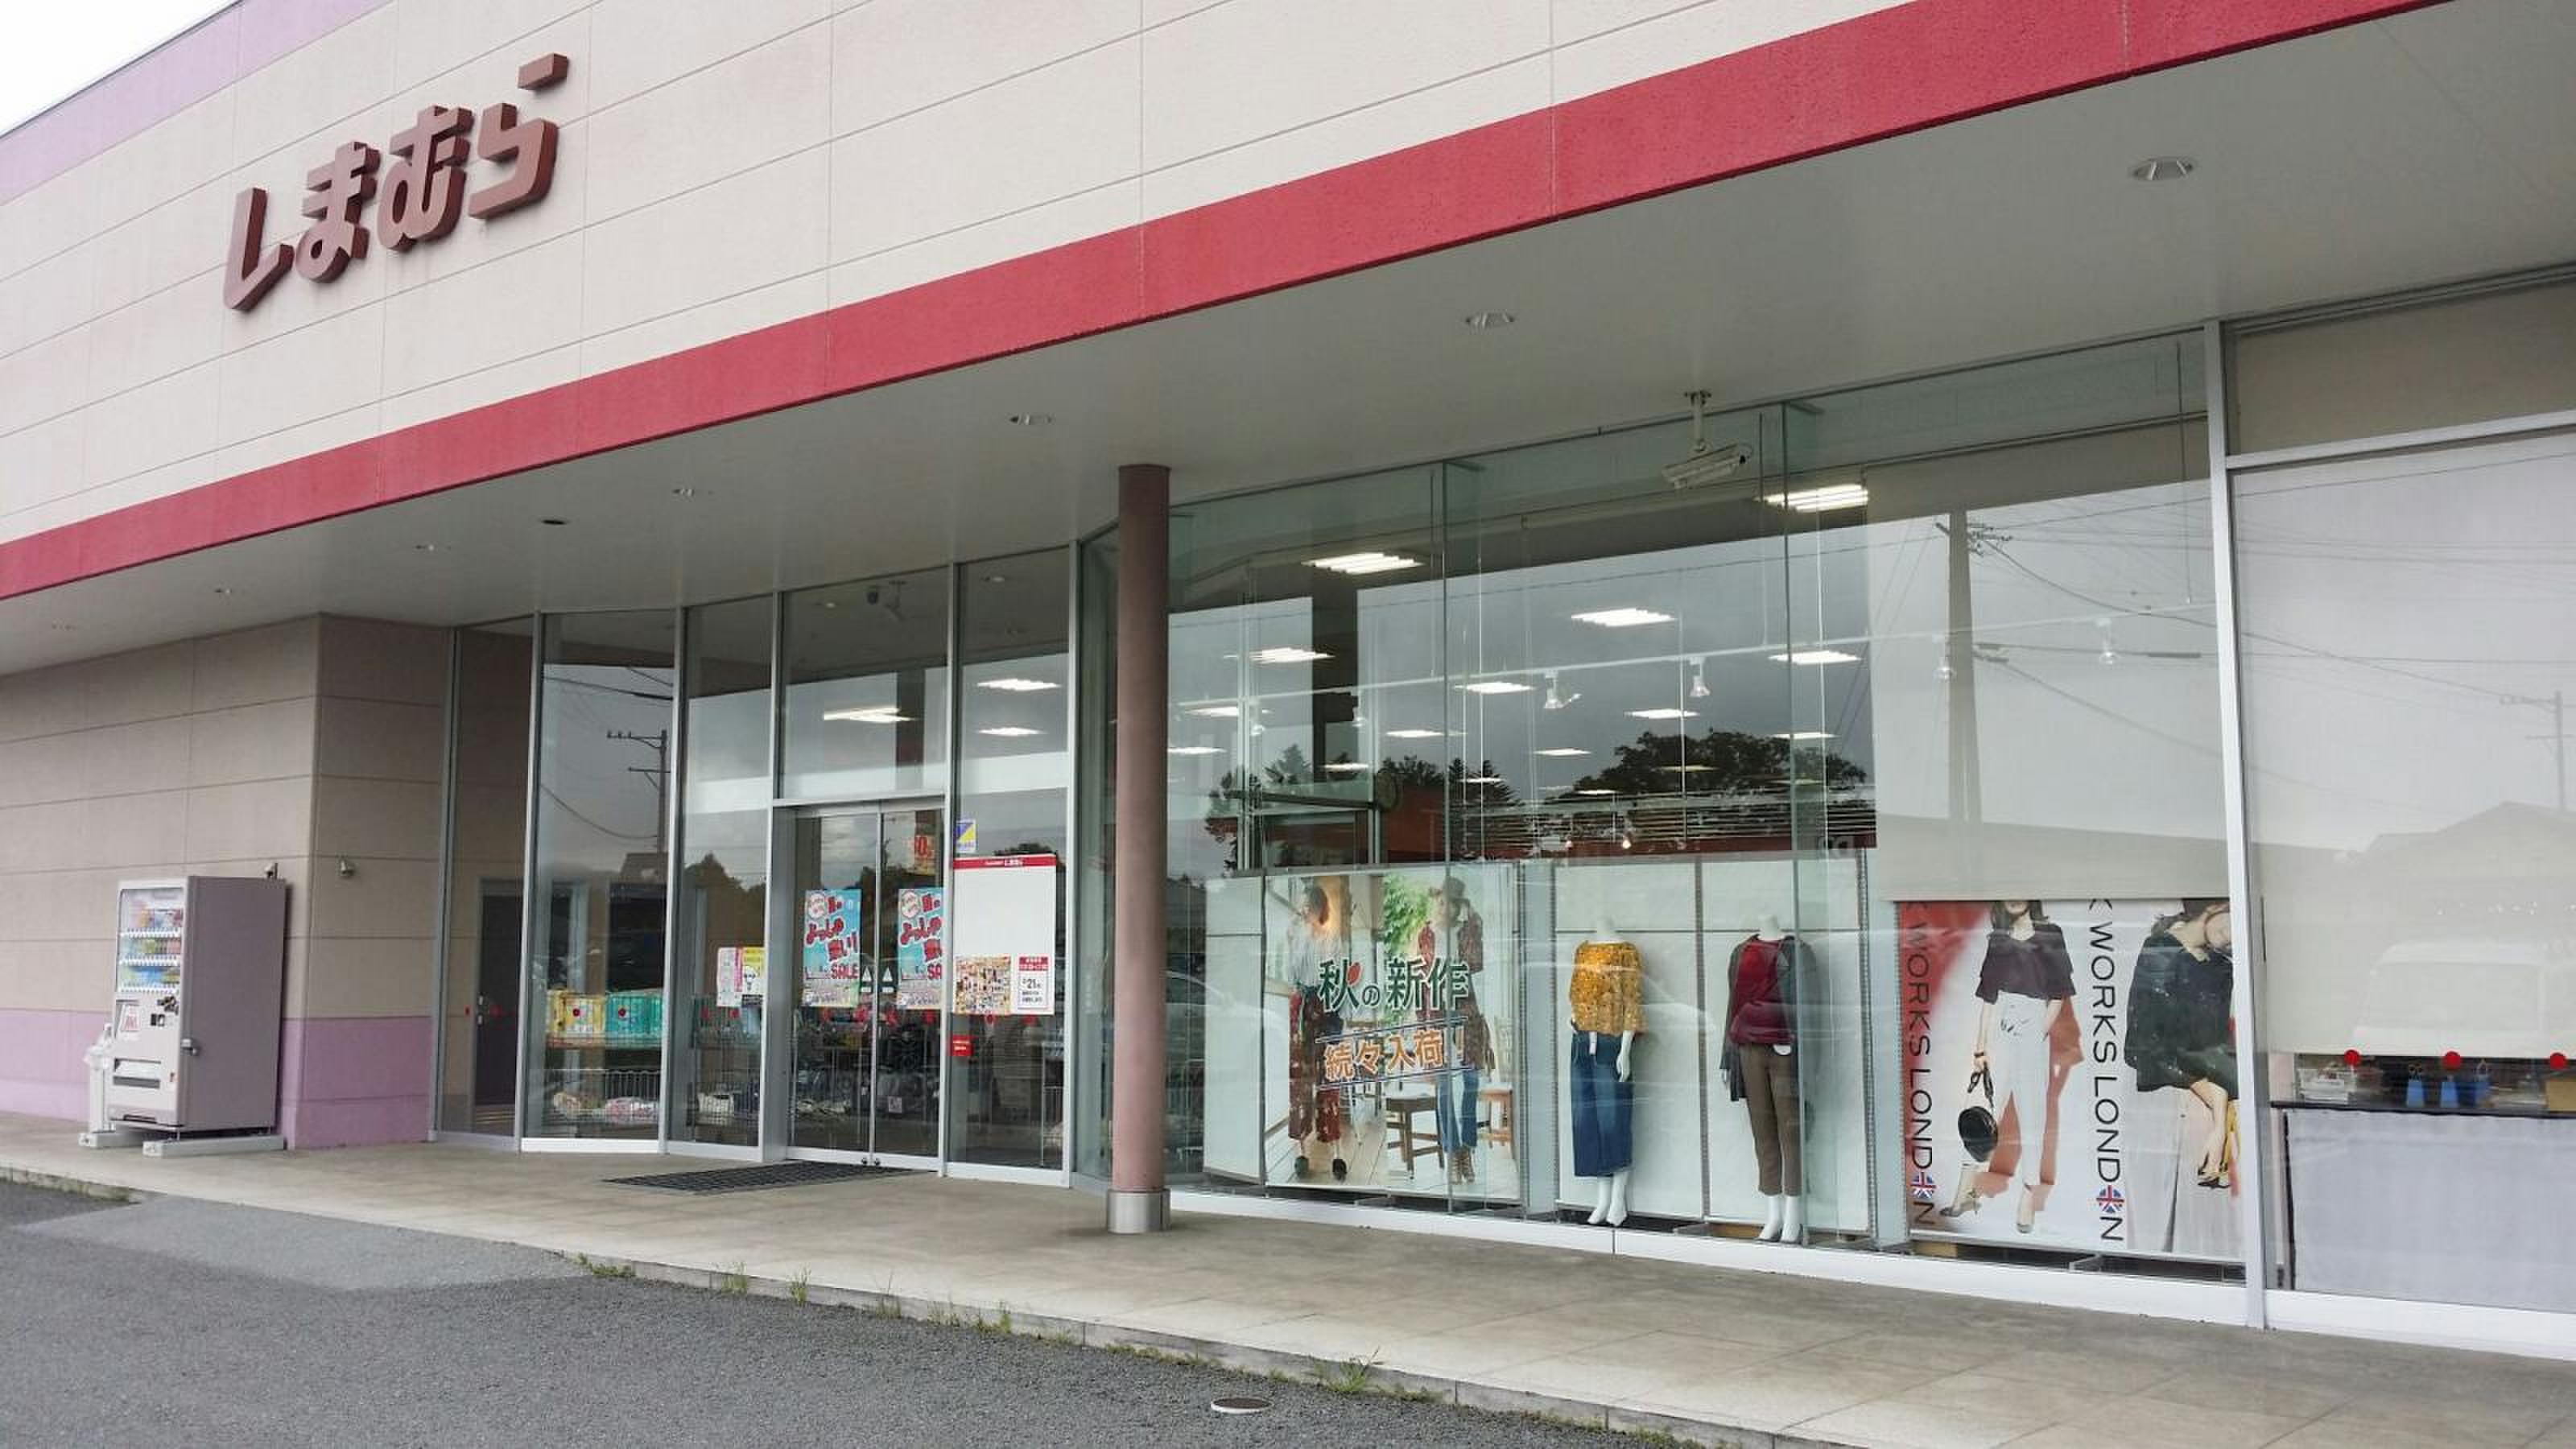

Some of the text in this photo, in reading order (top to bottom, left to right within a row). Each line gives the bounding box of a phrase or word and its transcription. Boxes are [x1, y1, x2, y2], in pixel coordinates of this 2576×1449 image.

[224, 53, 568, 310] しまむら
[831, 962, 858, 980] SALE
[1318, 956, 1469, 1012] 秋の新作
[1906, 922, 1930, 1057] WORKS
[2090, 921, 2117, 1063] WORKS
